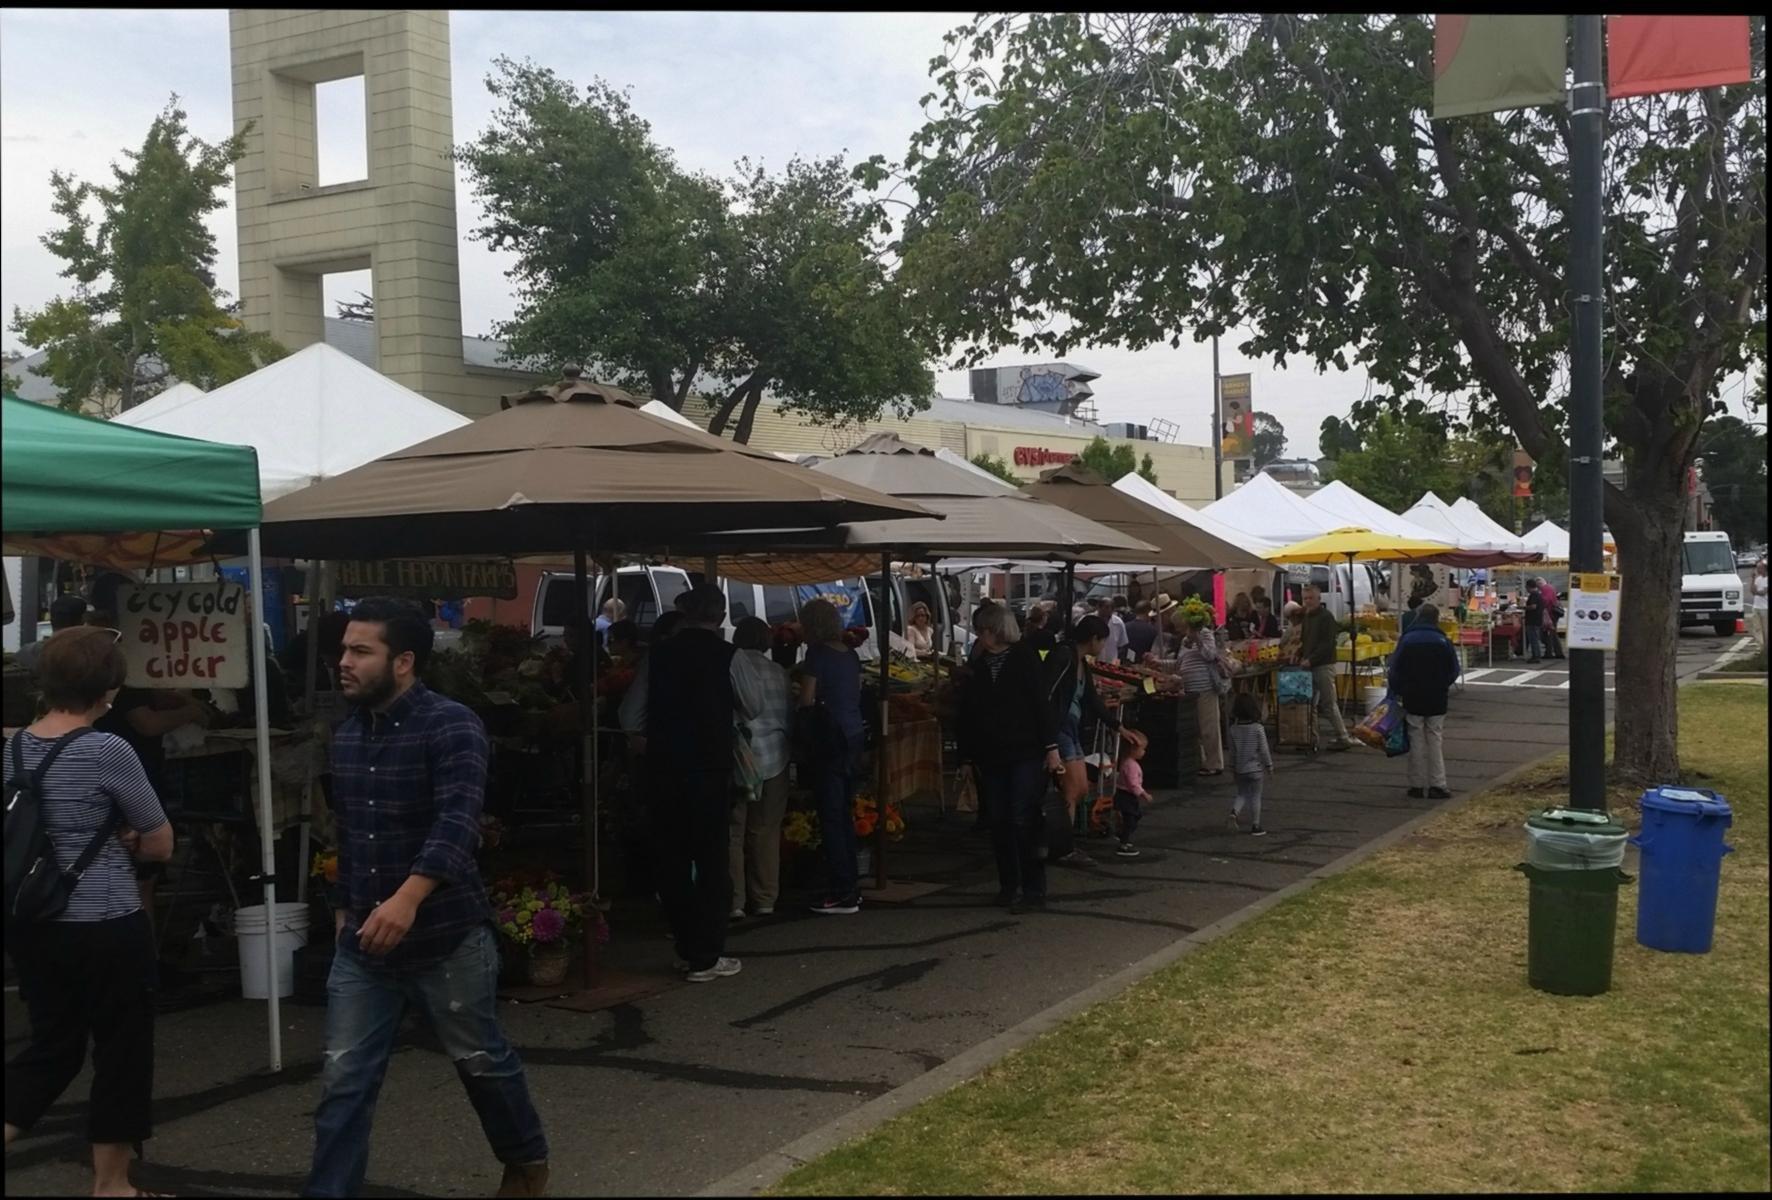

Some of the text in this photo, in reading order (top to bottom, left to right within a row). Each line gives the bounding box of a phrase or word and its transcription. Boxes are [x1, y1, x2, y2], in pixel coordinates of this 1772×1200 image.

[343, 560, 515, 588] BLUE HERON FARMS
[188, 585, 241, 615] cold
[139, 616, 227, 653] apple
[146, 653, 225, 678] cider
